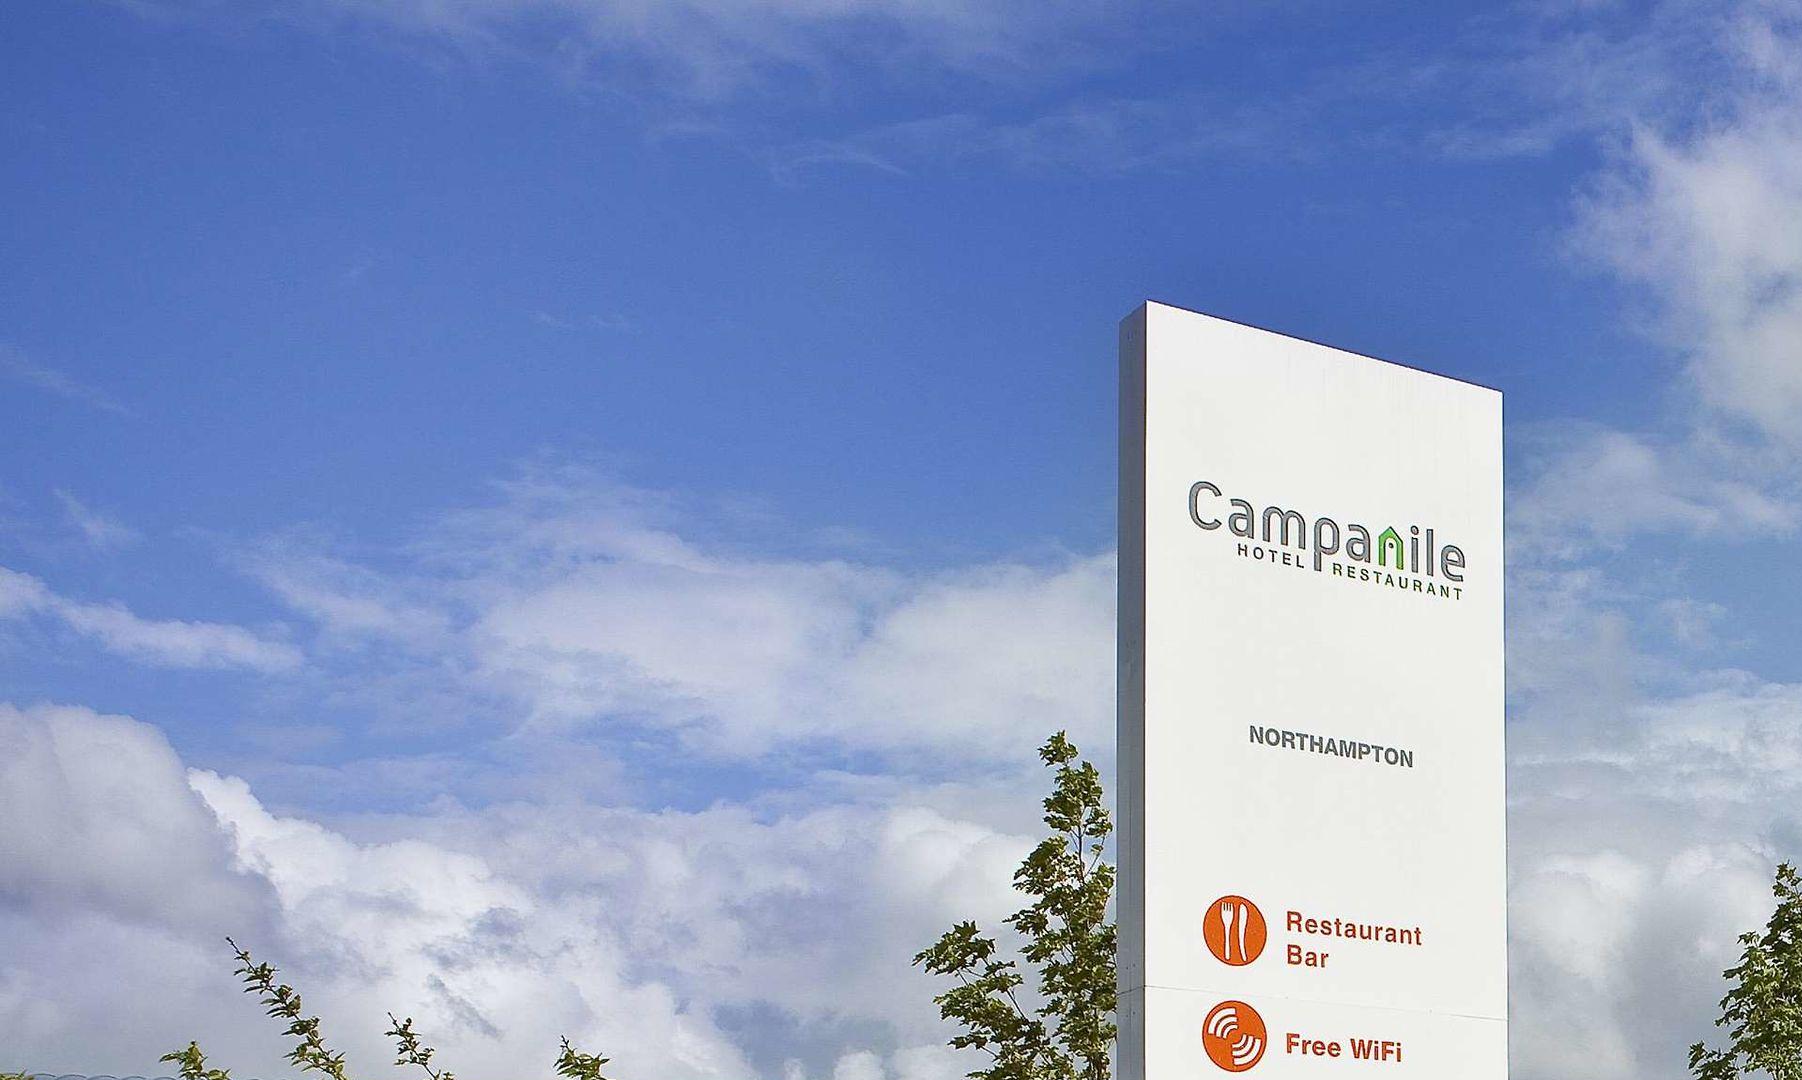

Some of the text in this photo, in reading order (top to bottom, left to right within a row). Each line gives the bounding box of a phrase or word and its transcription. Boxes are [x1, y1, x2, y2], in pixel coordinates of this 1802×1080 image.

[1188, 480, 1466, 583] Campanile
[1237, 542, 1464, 601] HOTEL RESTAURANT
[1249, 724, 1414, 769] NORTHAMPTON
[1286, 910, 1423, 946] Restaurant
[1286, 943, 1330, 969] Bar
[1285, 1032, 1402, 1063] Free WiFi
